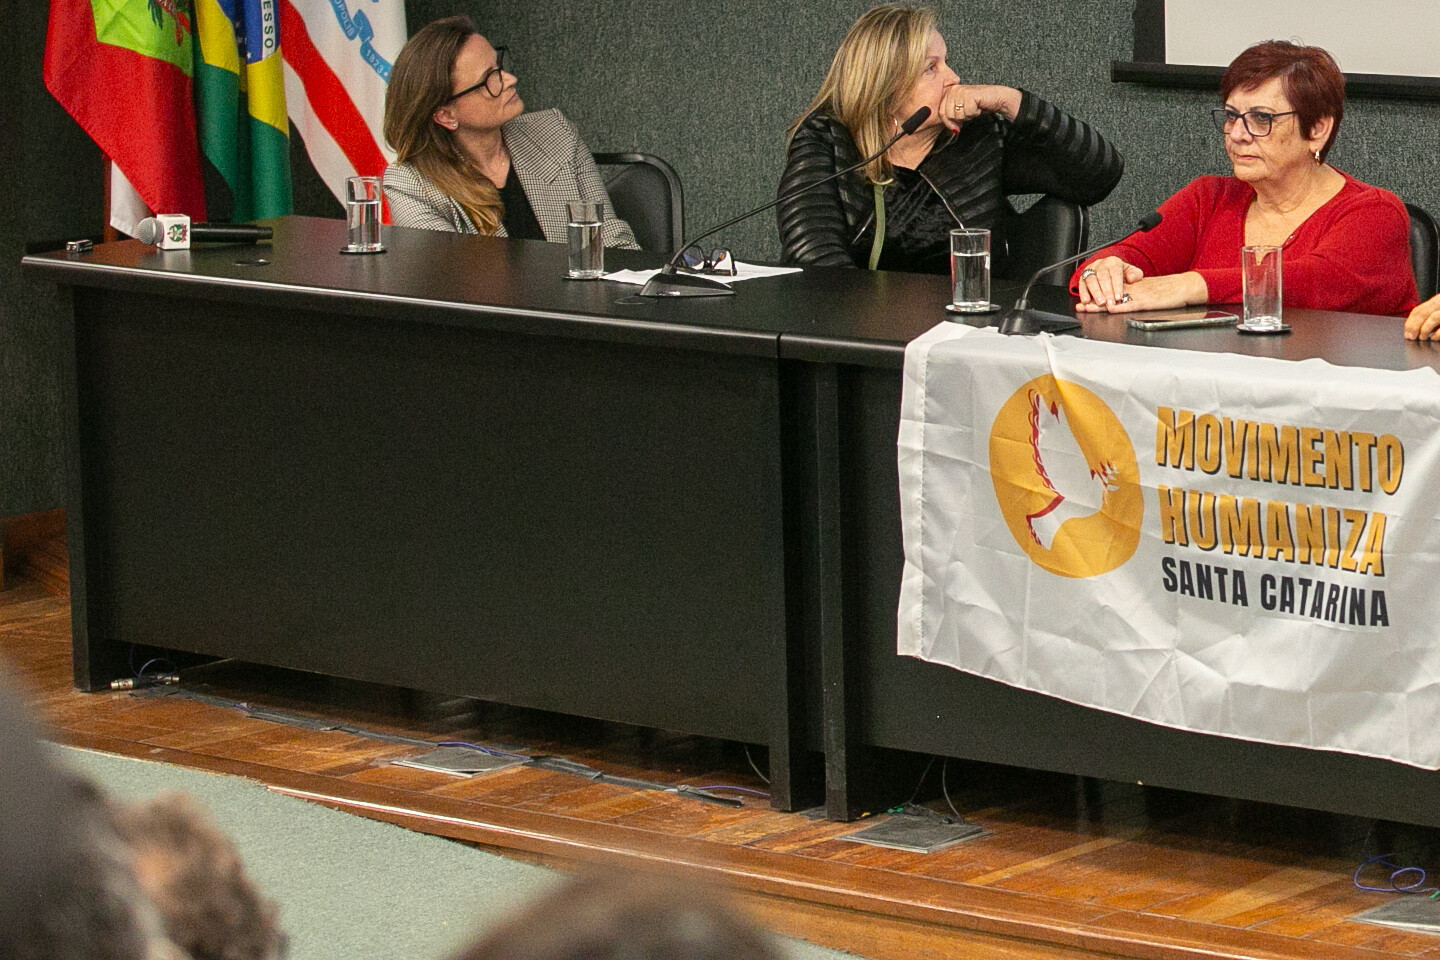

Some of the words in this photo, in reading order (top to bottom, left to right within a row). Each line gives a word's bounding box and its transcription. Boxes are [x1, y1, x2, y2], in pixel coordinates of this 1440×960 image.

[1155, 406, 1404, 495] MOVIMENTO
[1157, 484, 1387, 576] HUMANIZA
[1161, 556, 1249, 606] SANTA
[1260, 573, 1389, 627] CATARINA
